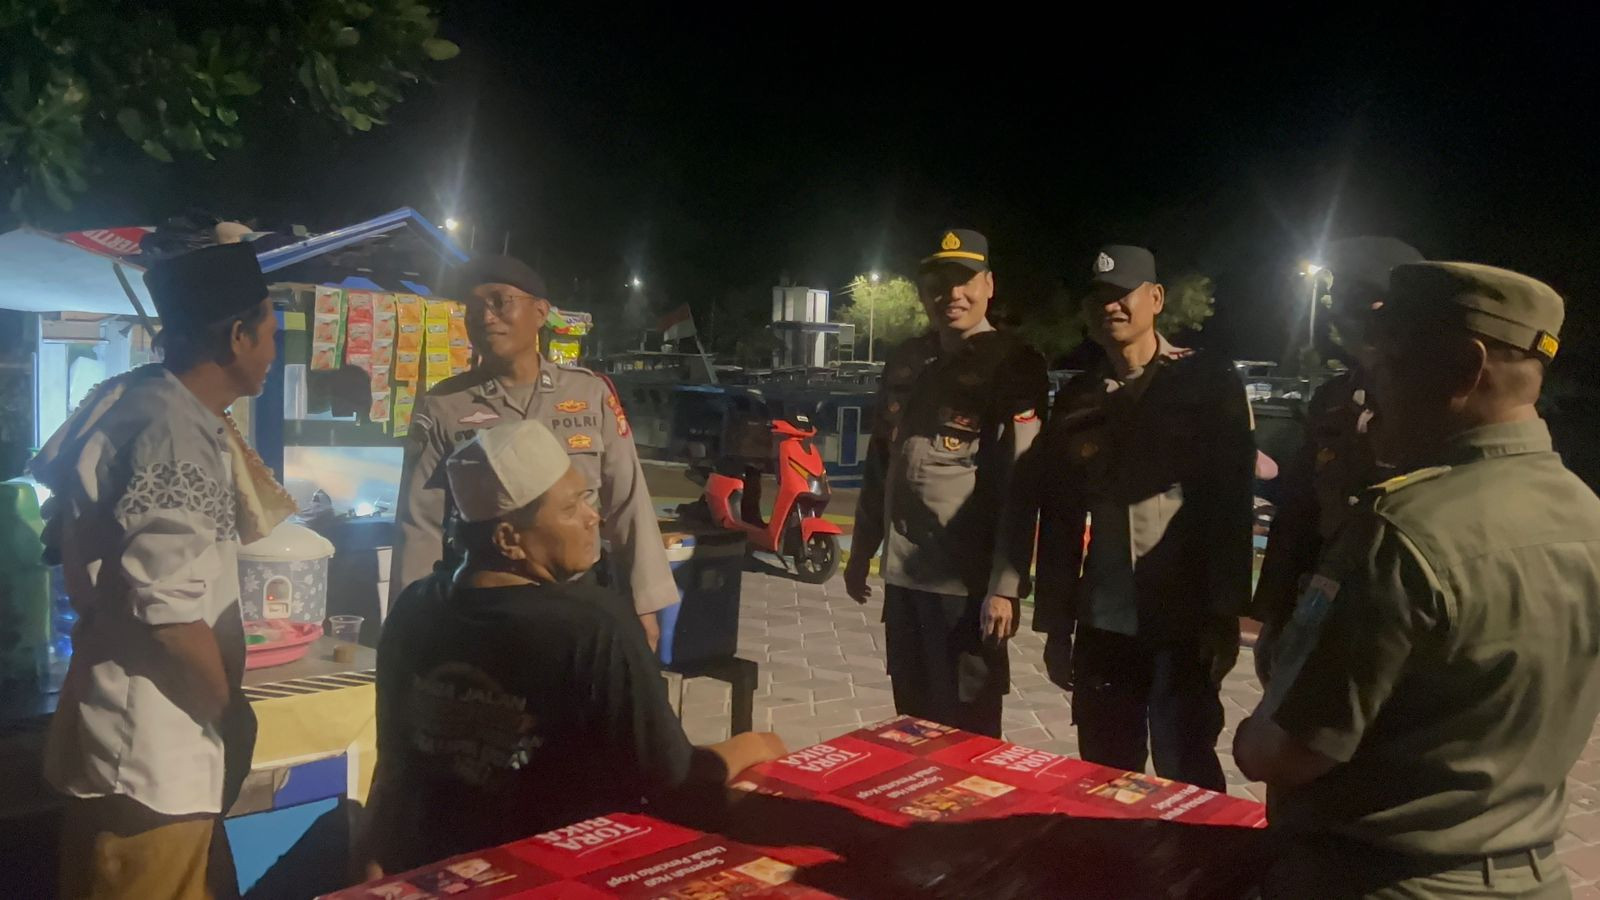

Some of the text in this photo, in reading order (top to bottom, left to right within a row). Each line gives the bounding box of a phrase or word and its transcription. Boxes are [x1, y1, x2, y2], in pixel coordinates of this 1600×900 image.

[551, 415, 597, 430] POLRI
[777, 744, 837, 766] BIKA
[797, 749, 861, 772] TORA
[983, 745, 1035, 766] BIKA
[1006, 751, 1060, 772] TORA
[534, 816, 613, 842] BIKA
[552, 823, 640, 851] TORA
[606, 872, 640, 888] Kopi
